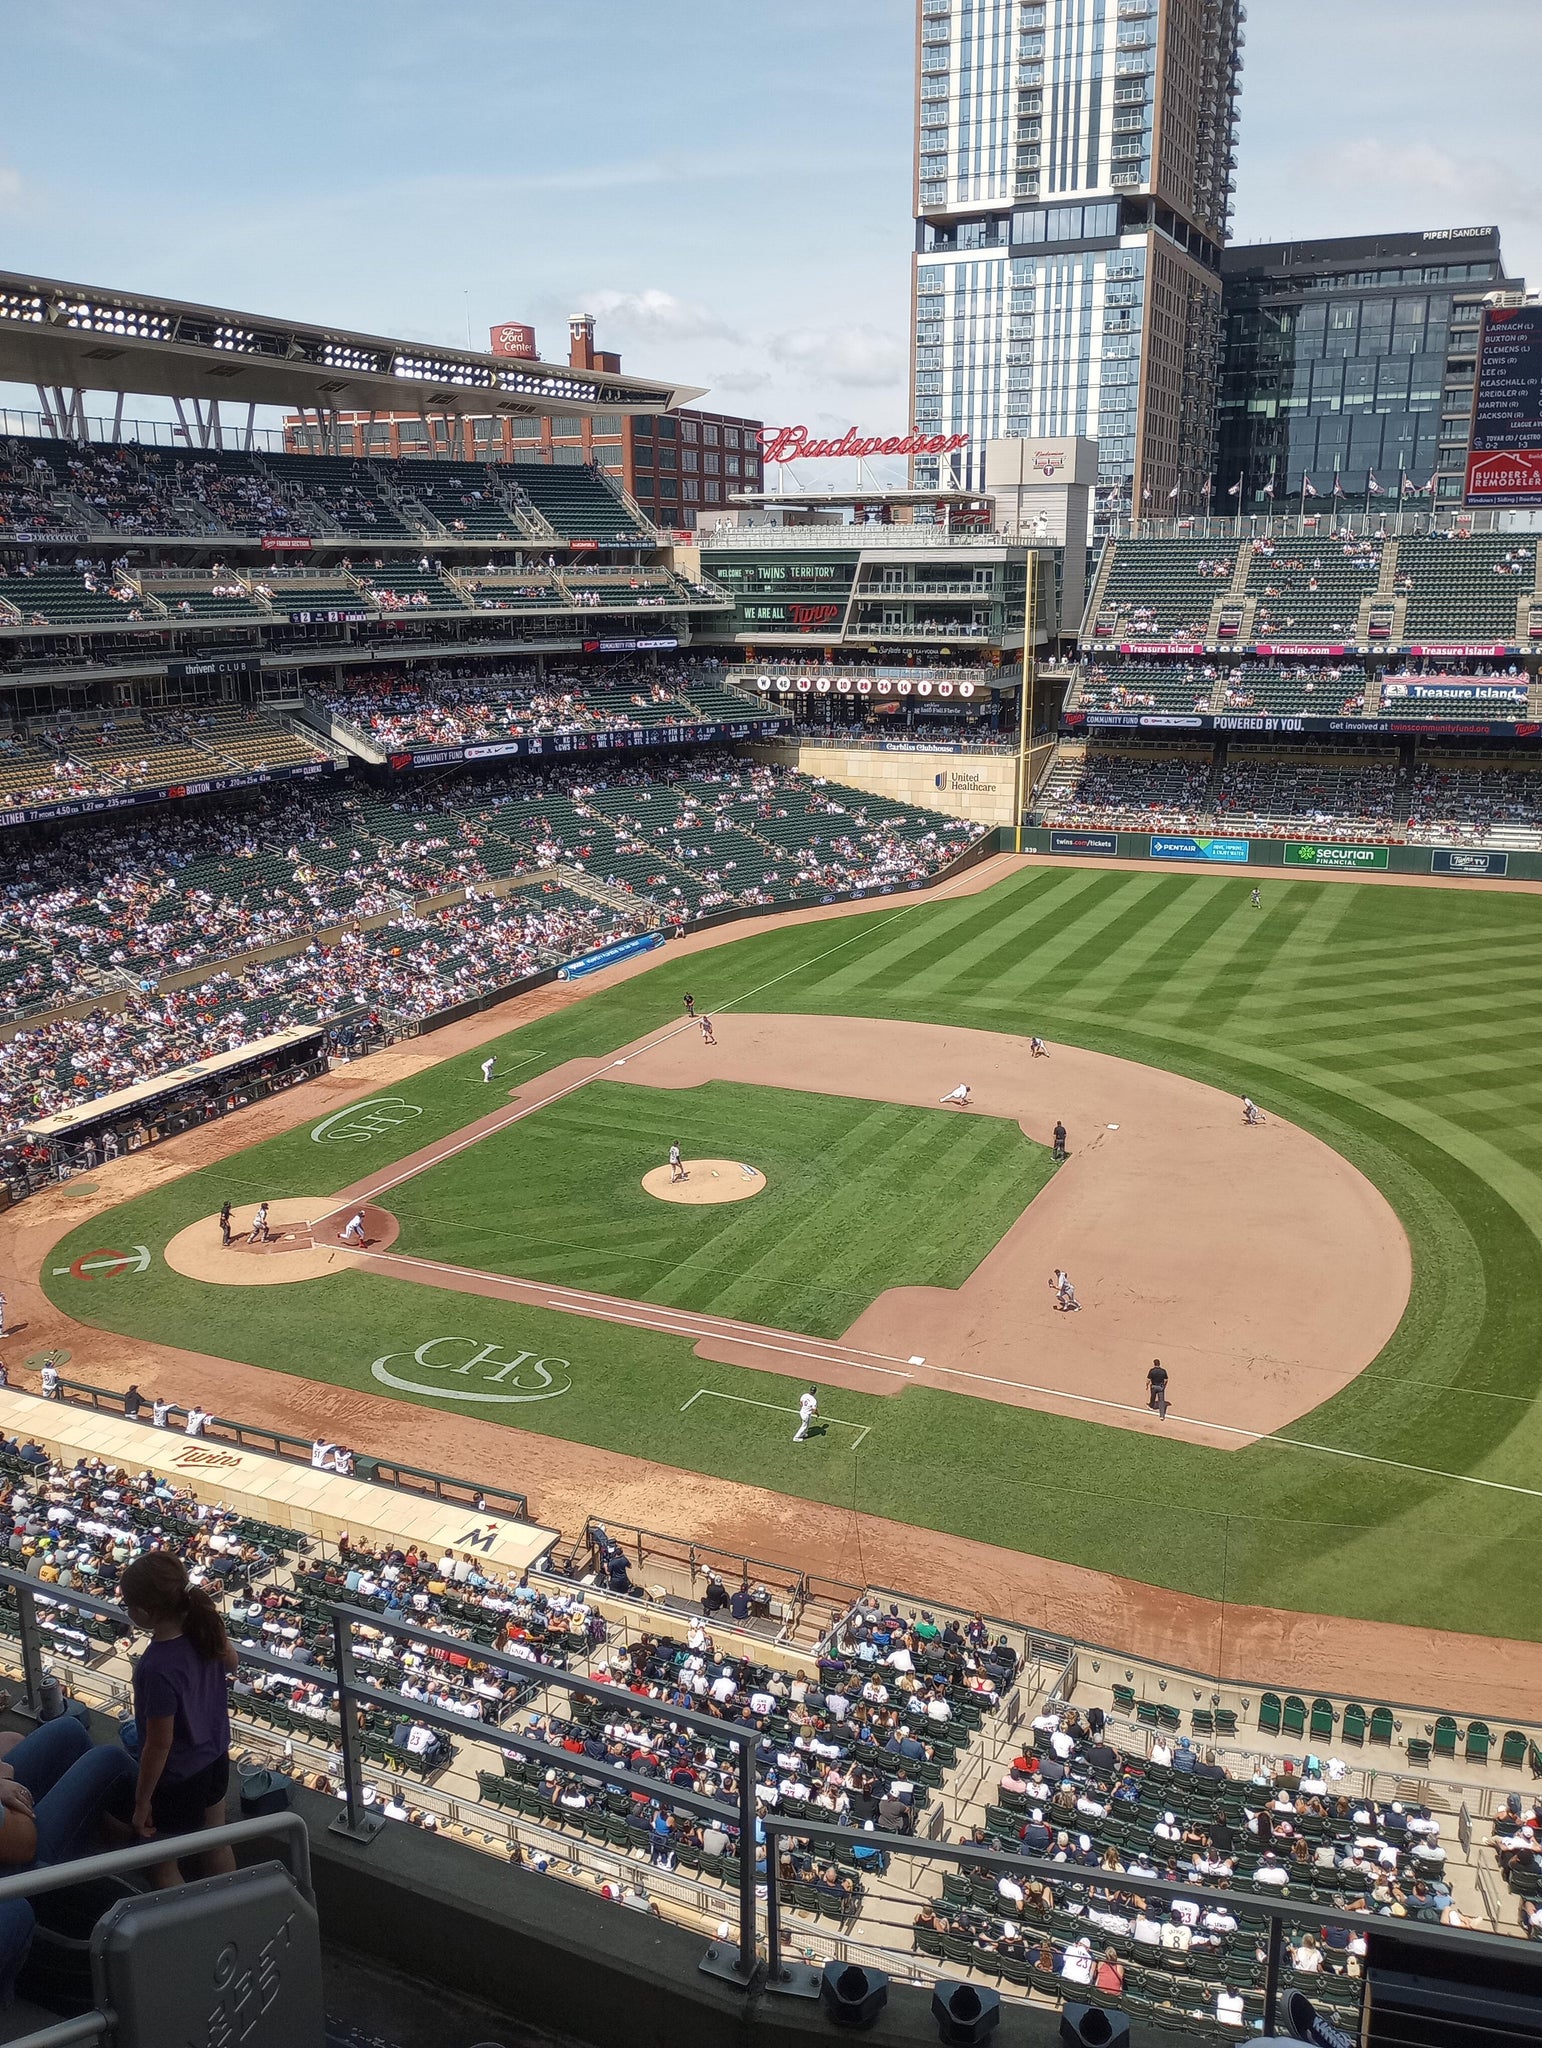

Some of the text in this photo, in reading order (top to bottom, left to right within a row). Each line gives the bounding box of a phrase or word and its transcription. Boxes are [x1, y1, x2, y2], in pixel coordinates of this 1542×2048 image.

[1423, 227, 1492, 240] PIPER SANDLER
[1486, 324, 1523, 332] LARNACH
[500, 327, 523, 342] Ford
[1485, 335, 1516, 343] BUXTON
[504, 342, 532, 352] Center
[1483, 346, 1520, 354] CLEMENS
[1480, 379, 1526, 387] KEASCHALL
[1480, 390, 1517, 398] KREIDLER
[1478, 401, 1508, 409] MARTIN
[1477, 412, 1512, 420] JACKSON
[755, 425, 970, 463] Budweiser
[1475, 470, 1540, 479] BUILDERS &
[717, 569, 742, 578] WELCOME
[758, 567, 786, 579] TWINS
[791, 566, 835, 578] TERRITORY
[744, 604, 839, 627] WE ARE ALL Twins
[1129, 645, 1194, 654] Treasure Island
[1420, 646, 1496, 656] Treasure Island
[185, 662, 247, 675] thrivent CLUB
[779, 679, 788, 688] 42
[821, 680, 826, 690] 7
[840, 681, 848, 690] 10
[880, 682, 888, 691] 34
[900, 682, 908, 691] 14
[964, 685, 969, 694] 3
[1414, 687, 1517, 699] Treasure Island
[1064, 713, 1540, 737] Twins COMMUNITY FUND POWERED BY YOU. Get involved at twinscommunityfund.org Twins
[886, 743, 954, 753] Carbliss Clubhouse
[390, 752, 412, 769] Twins
[413, 753, 448, 765] COMMUNITY
[449, 751, 463, 761] FUND
[951, 771, 979, 783] United
[951, 780, 997, 793] Healthcare
[30, 810, 38, 820] 77
[56, 806, 70, 816] 4.50
[82, 802, 94, 811] 1.27
[106, 799, 119, 808] .235
[186, 781, 210, 795] BUXTON
[215, 780, 226, 789] 0-2
[1056, 838, 1112, 848] twins.com/tickets
[1163, 843, 1196, 852] PENTAIR
[1316, 848, 1374, 860] securian
[1316, 858, 1357, 866] FINANCIAL
[327, 1104, 423, 1142] CHS
[415, 1336, 571, 1390] CHS
[170, 1446, 244, 1468] Twins
[757, 1703, 767, 1712] 23
[410, 1735, 420, 1746] 23
[1173, 1935, 1180, 1949] 8
[1076, 1957, 1088, 1969] 23
